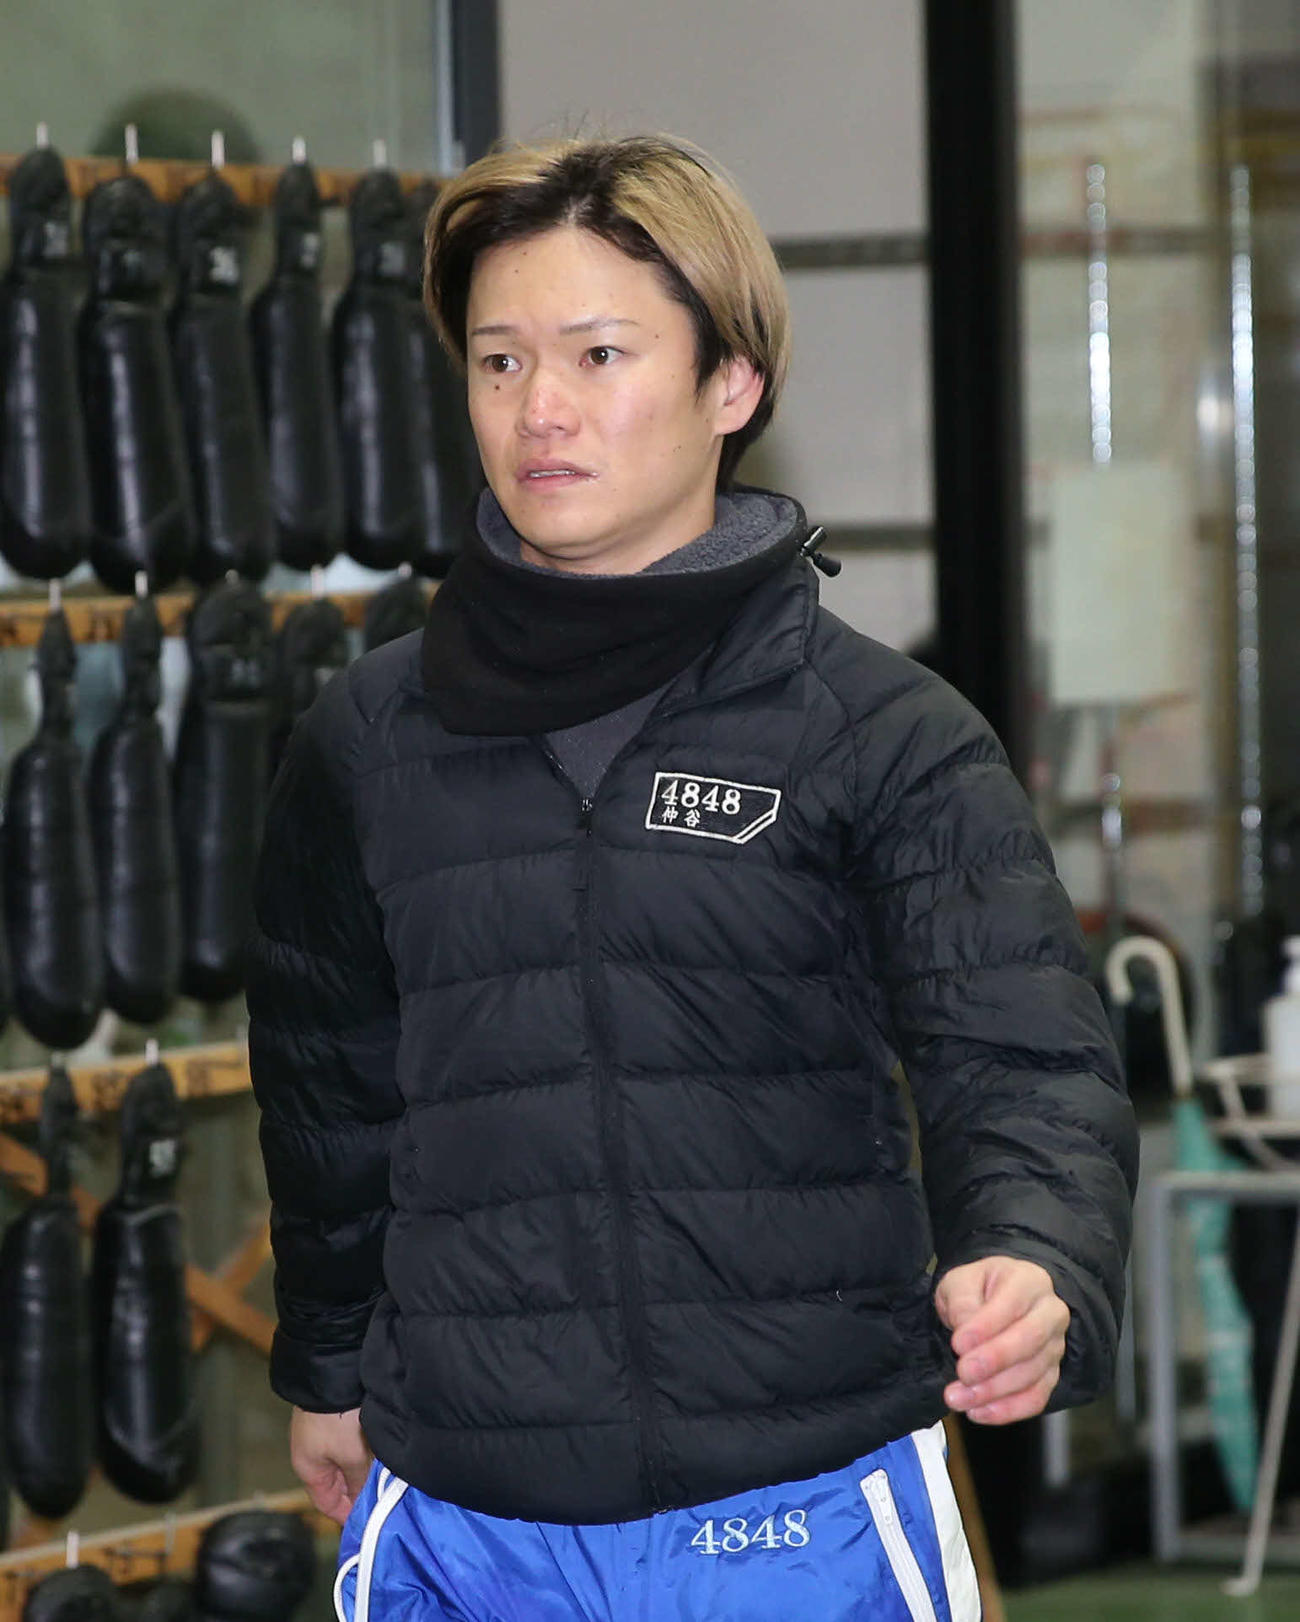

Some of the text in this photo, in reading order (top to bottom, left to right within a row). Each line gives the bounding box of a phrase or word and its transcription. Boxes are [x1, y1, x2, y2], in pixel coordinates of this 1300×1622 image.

[661, 779, 741, 815] 4848
[661, 806, 700, 827] 仲谷
[691, 1509, 811, 1554] 4848
